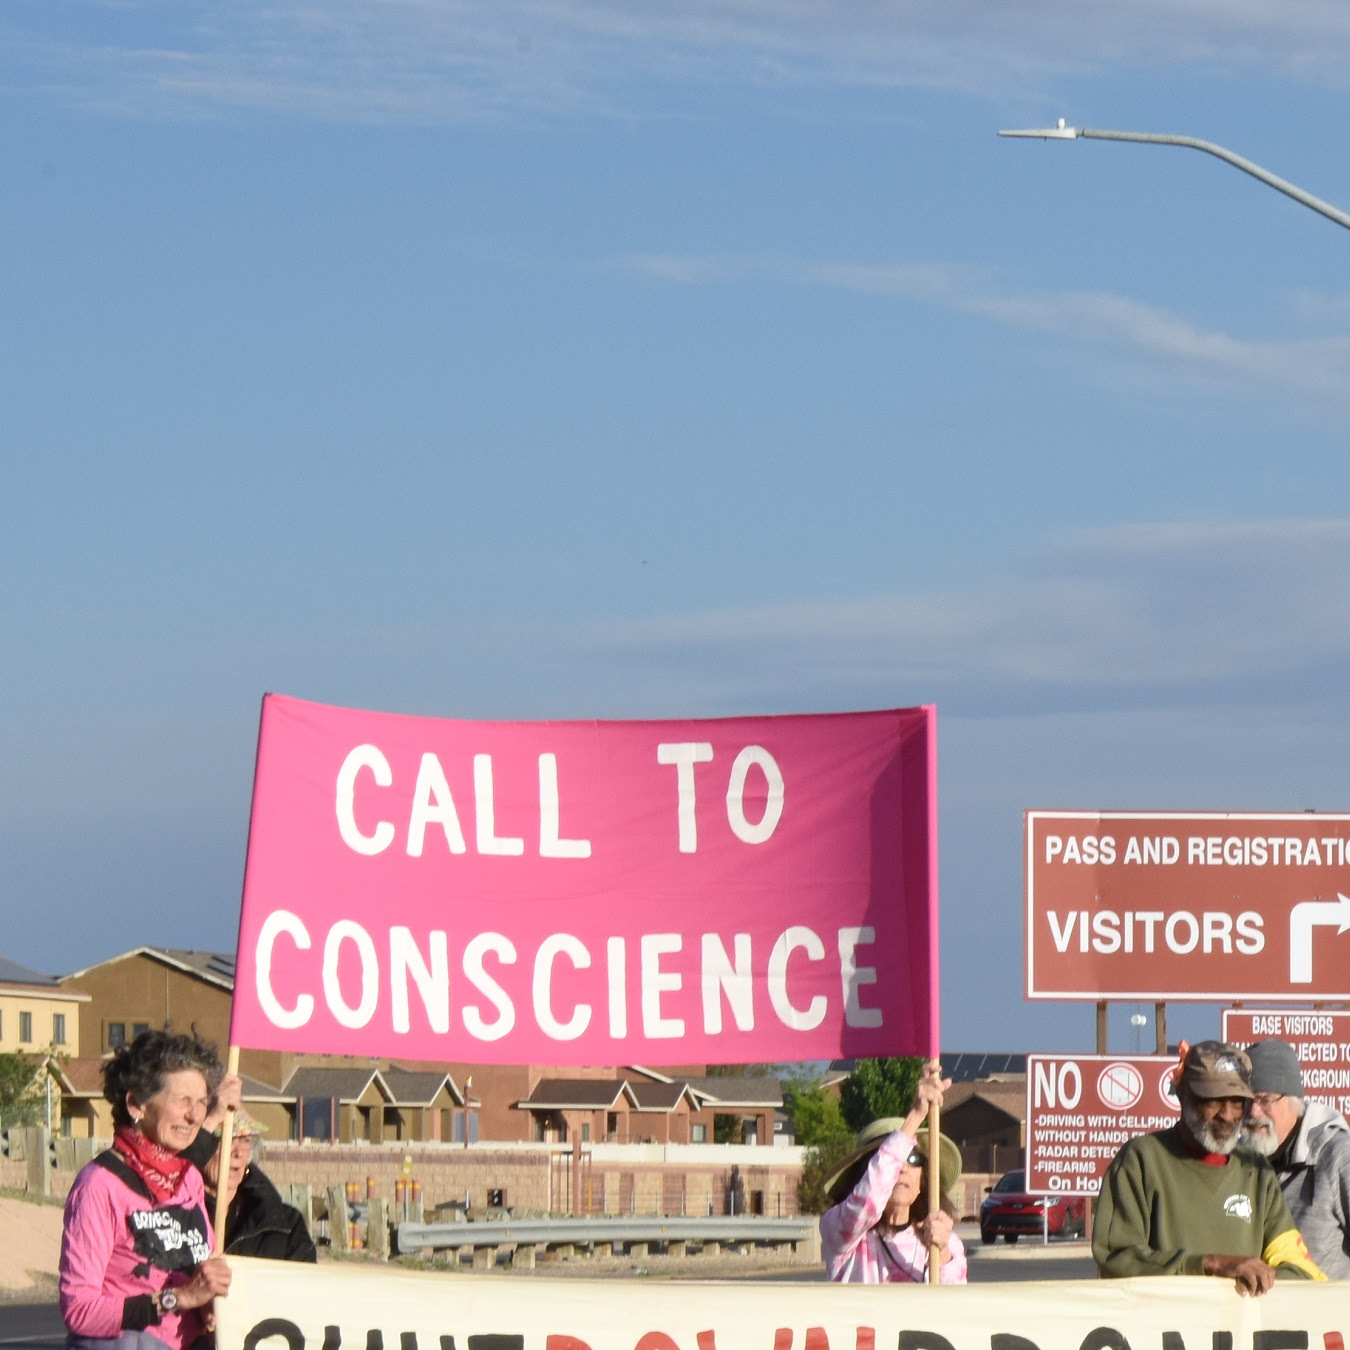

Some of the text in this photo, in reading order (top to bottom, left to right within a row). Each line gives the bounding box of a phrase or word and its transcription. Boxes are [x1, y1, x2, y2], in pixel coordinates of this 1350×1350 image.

[336, 742, 785, 858] CALL TO
[1046, 836, 1116, 865] PASS
[1124, 837, 1180, 865] AND
[1047, 911, 1265, 954] VISITORS
[255, 910, 883, 1041] CONSCIENCE
[1252, 1016, 1333, 1035] BASE VISITORS
[1290, 1043, 1338, 1062] JECTED
[1035, 1061, 1082, 1109] NO
[1088, 1115, 1116, 1128] WITH
[1119, 1115, 1180, 1129] CELLPHON
[1035, 1130, 1086, 1143] WITHOUT
[1089, 1131, 1129, 1144] HANDS
[1081, 1146, 1121, 1159] DETEC
[1048, 1175, 1103, 1191] On Hol
